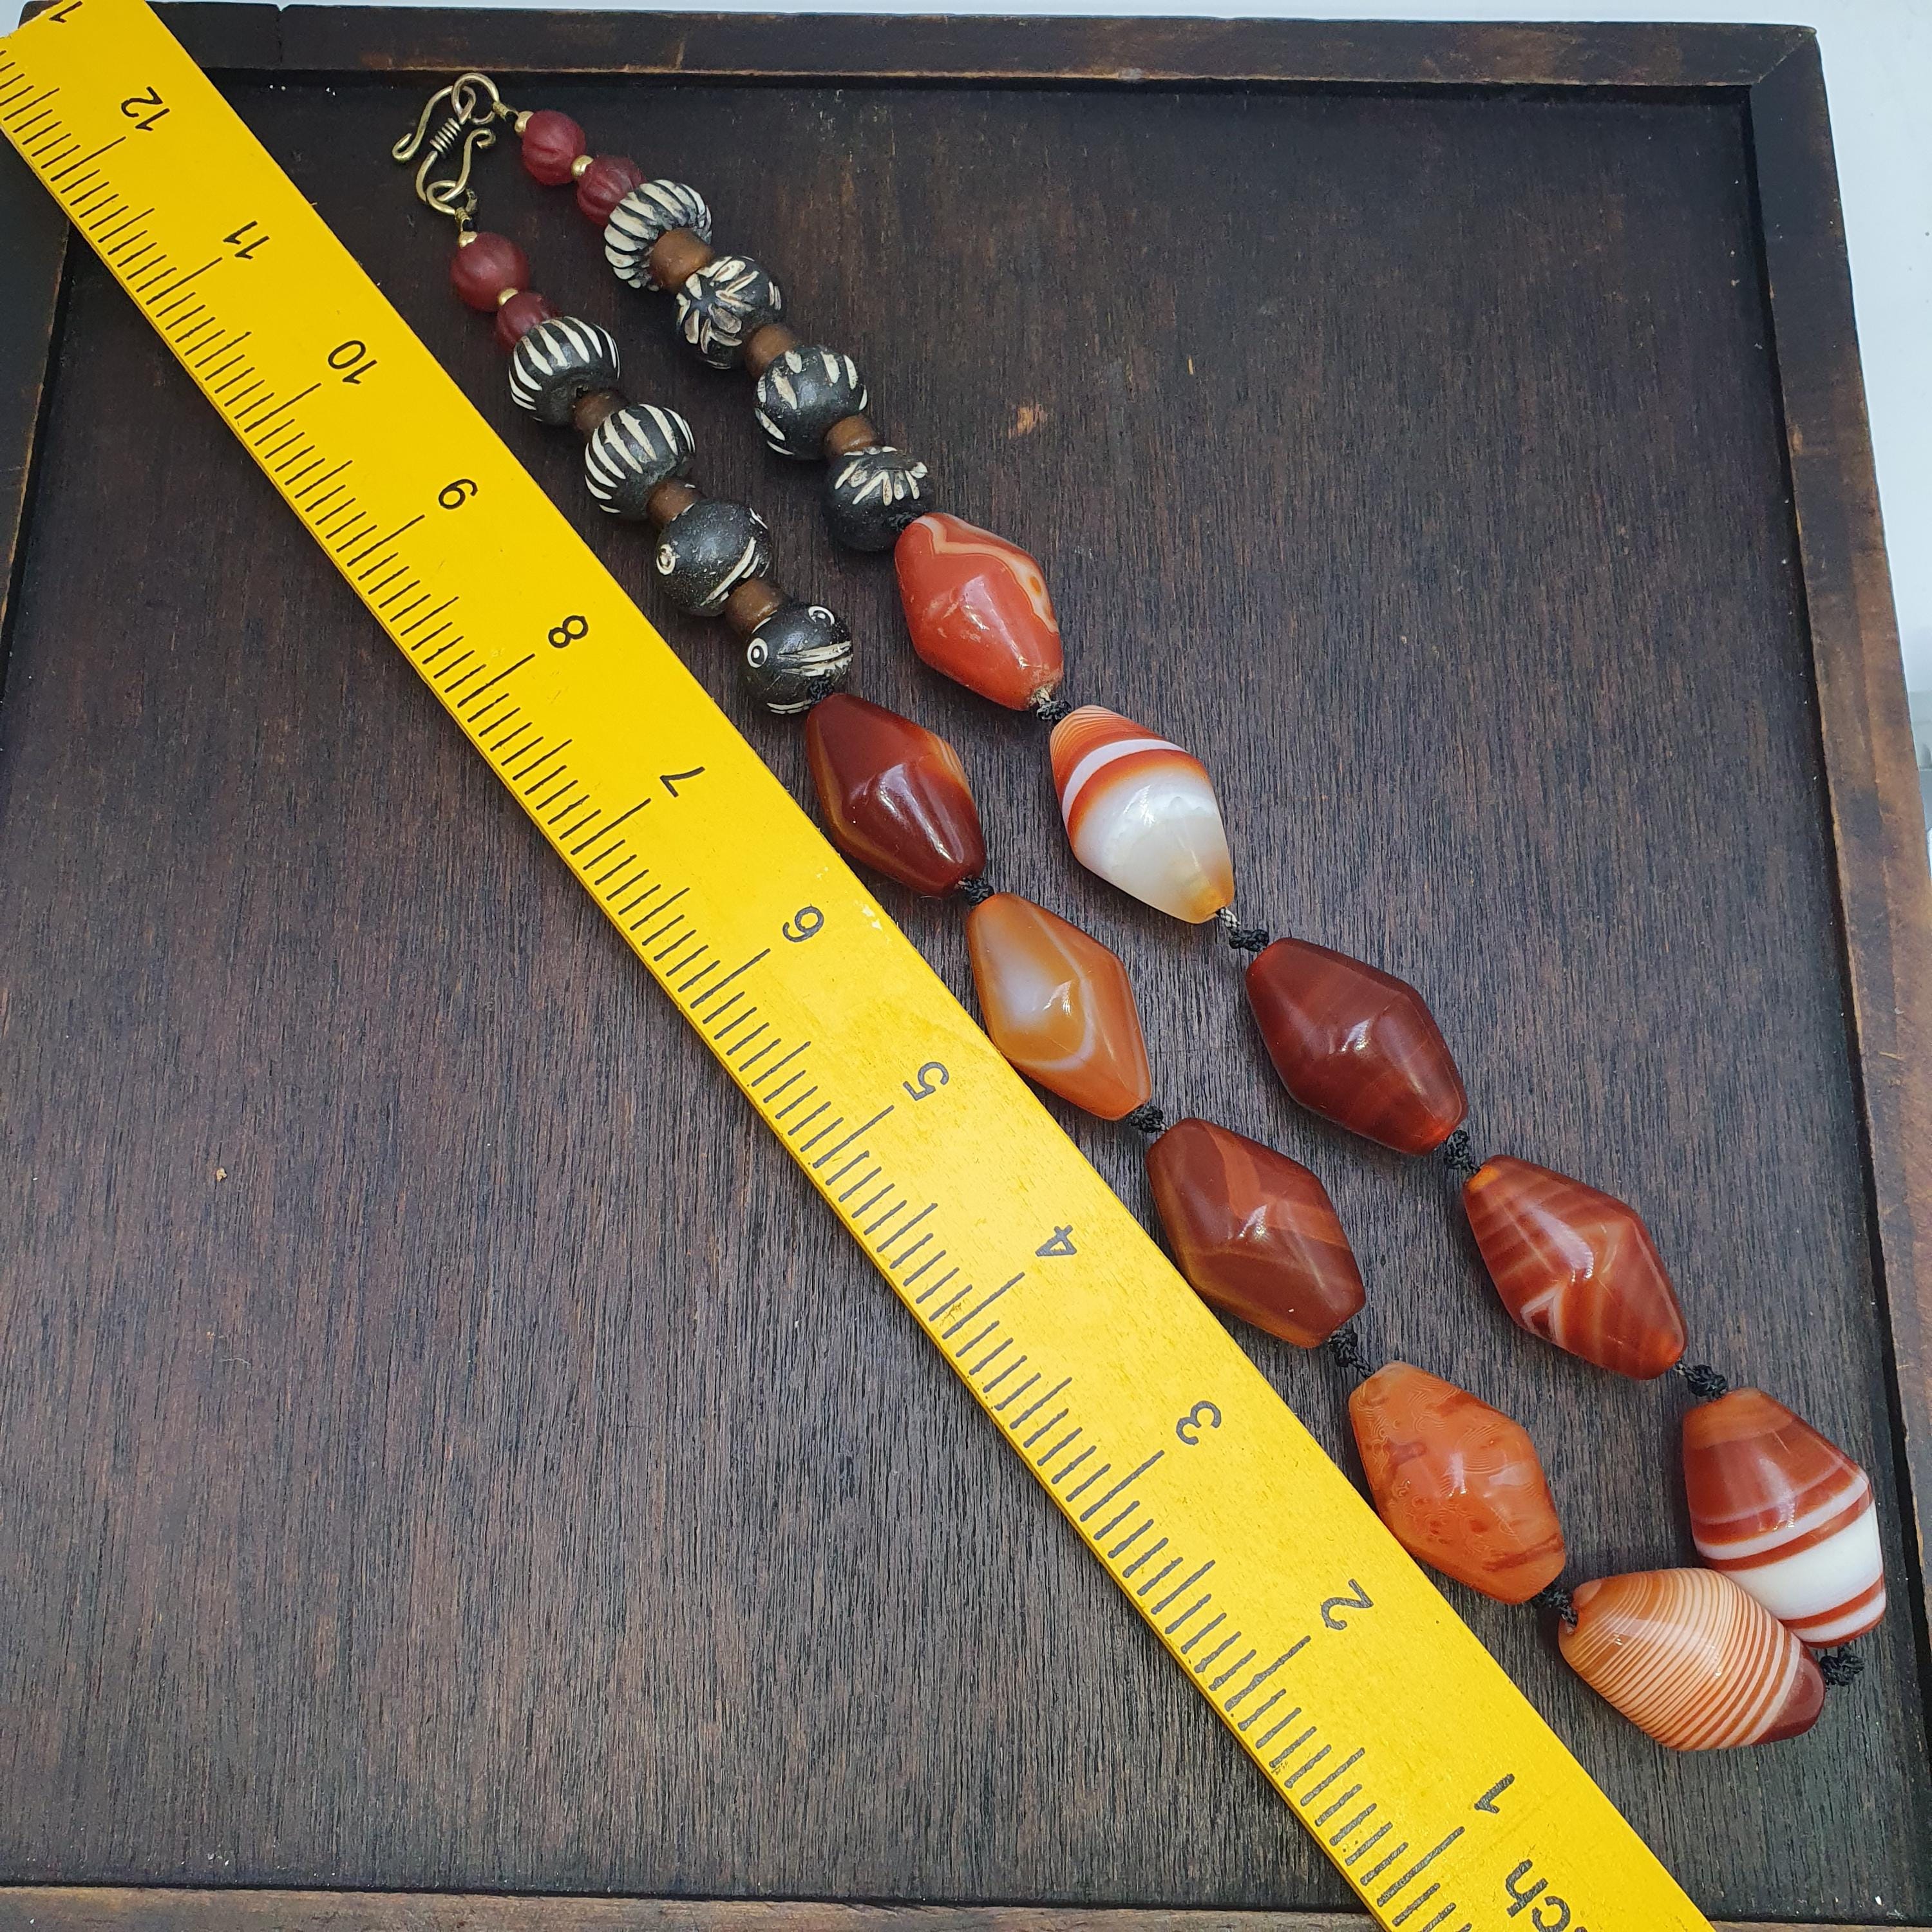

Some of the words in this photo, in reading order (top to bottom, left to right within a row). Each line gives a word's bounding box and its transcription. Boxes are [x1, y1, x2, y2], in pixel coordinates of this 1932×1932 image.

[120, 86, 170, 131] 12
[223, 220, 270, 260] 11
[327, 340, 377, 384] 10
[438, 478, 478, 510] 9
[548, 615, 589, 649] 8
[659, 766, 705, 798] 7
[782, 905, 824, 943] 6
[902, 1061, 949, 1101] 5
[1035, 1225, 1077, 1257] 4
[1176, 1401, 1222, 1446] 3
[1321, 1578, 1374, 1631] 2
[1473, 1773, 1515, 1814] 1
[1505, 1859, 1587, 1932] ch
